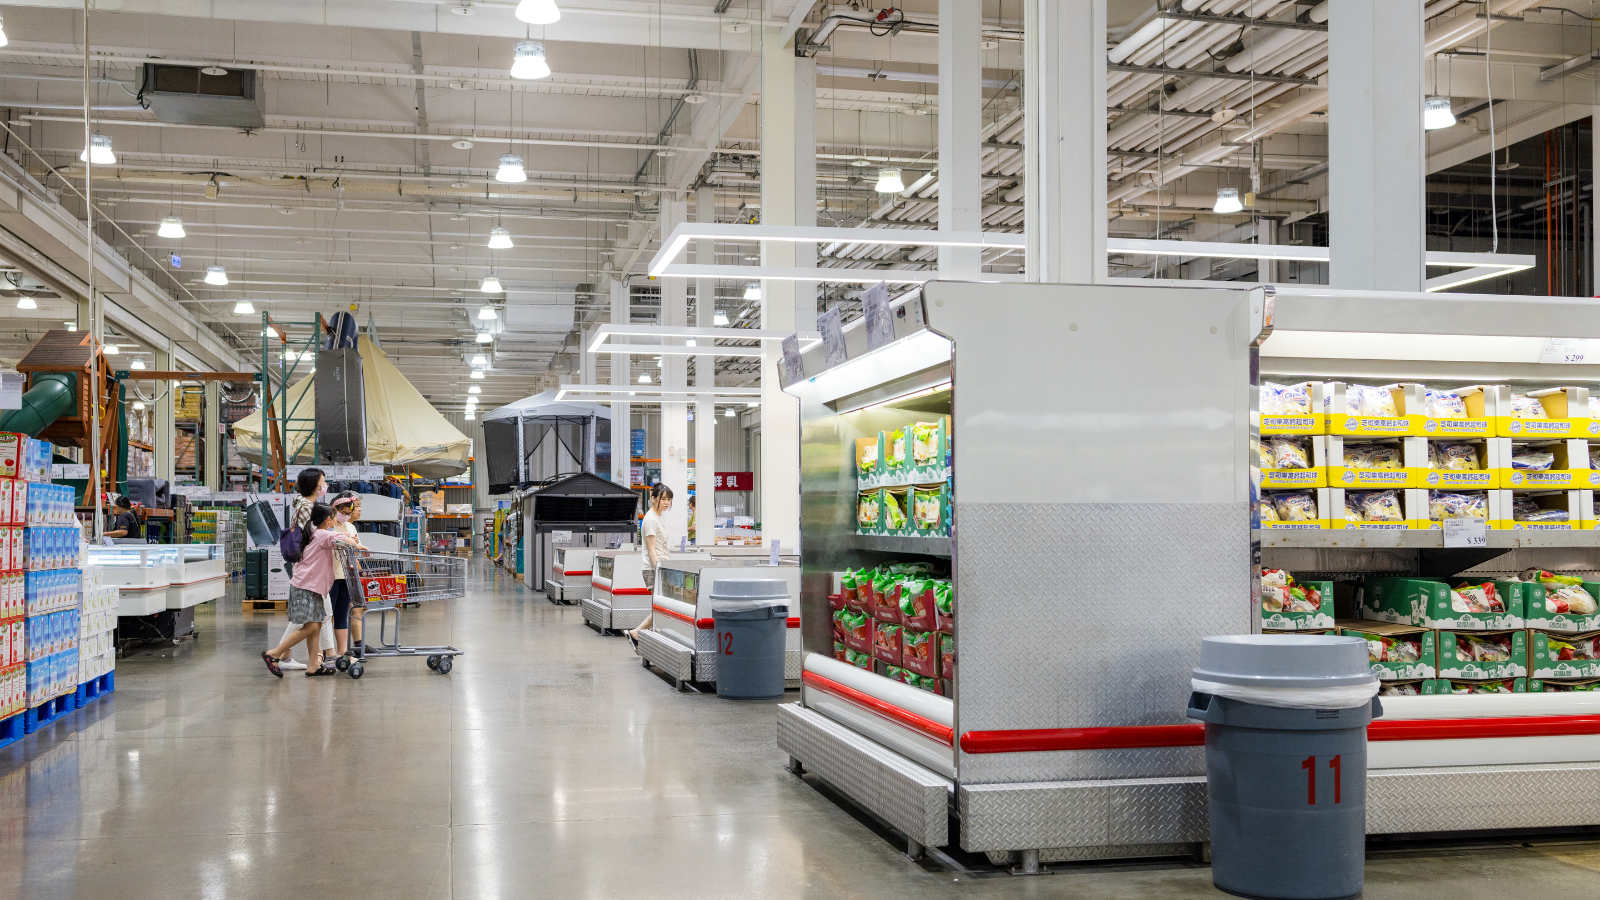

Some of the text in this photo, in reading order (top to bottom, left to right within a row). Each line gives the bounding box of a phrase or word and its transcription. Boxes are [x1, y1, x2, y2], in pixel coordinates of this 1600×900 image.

[1571, 354, 1584, 362] 299
[1467, 537, 1472, 545] $
[717, 632, 734, 656] 12
[1302, 754, 1341, 805] 11
